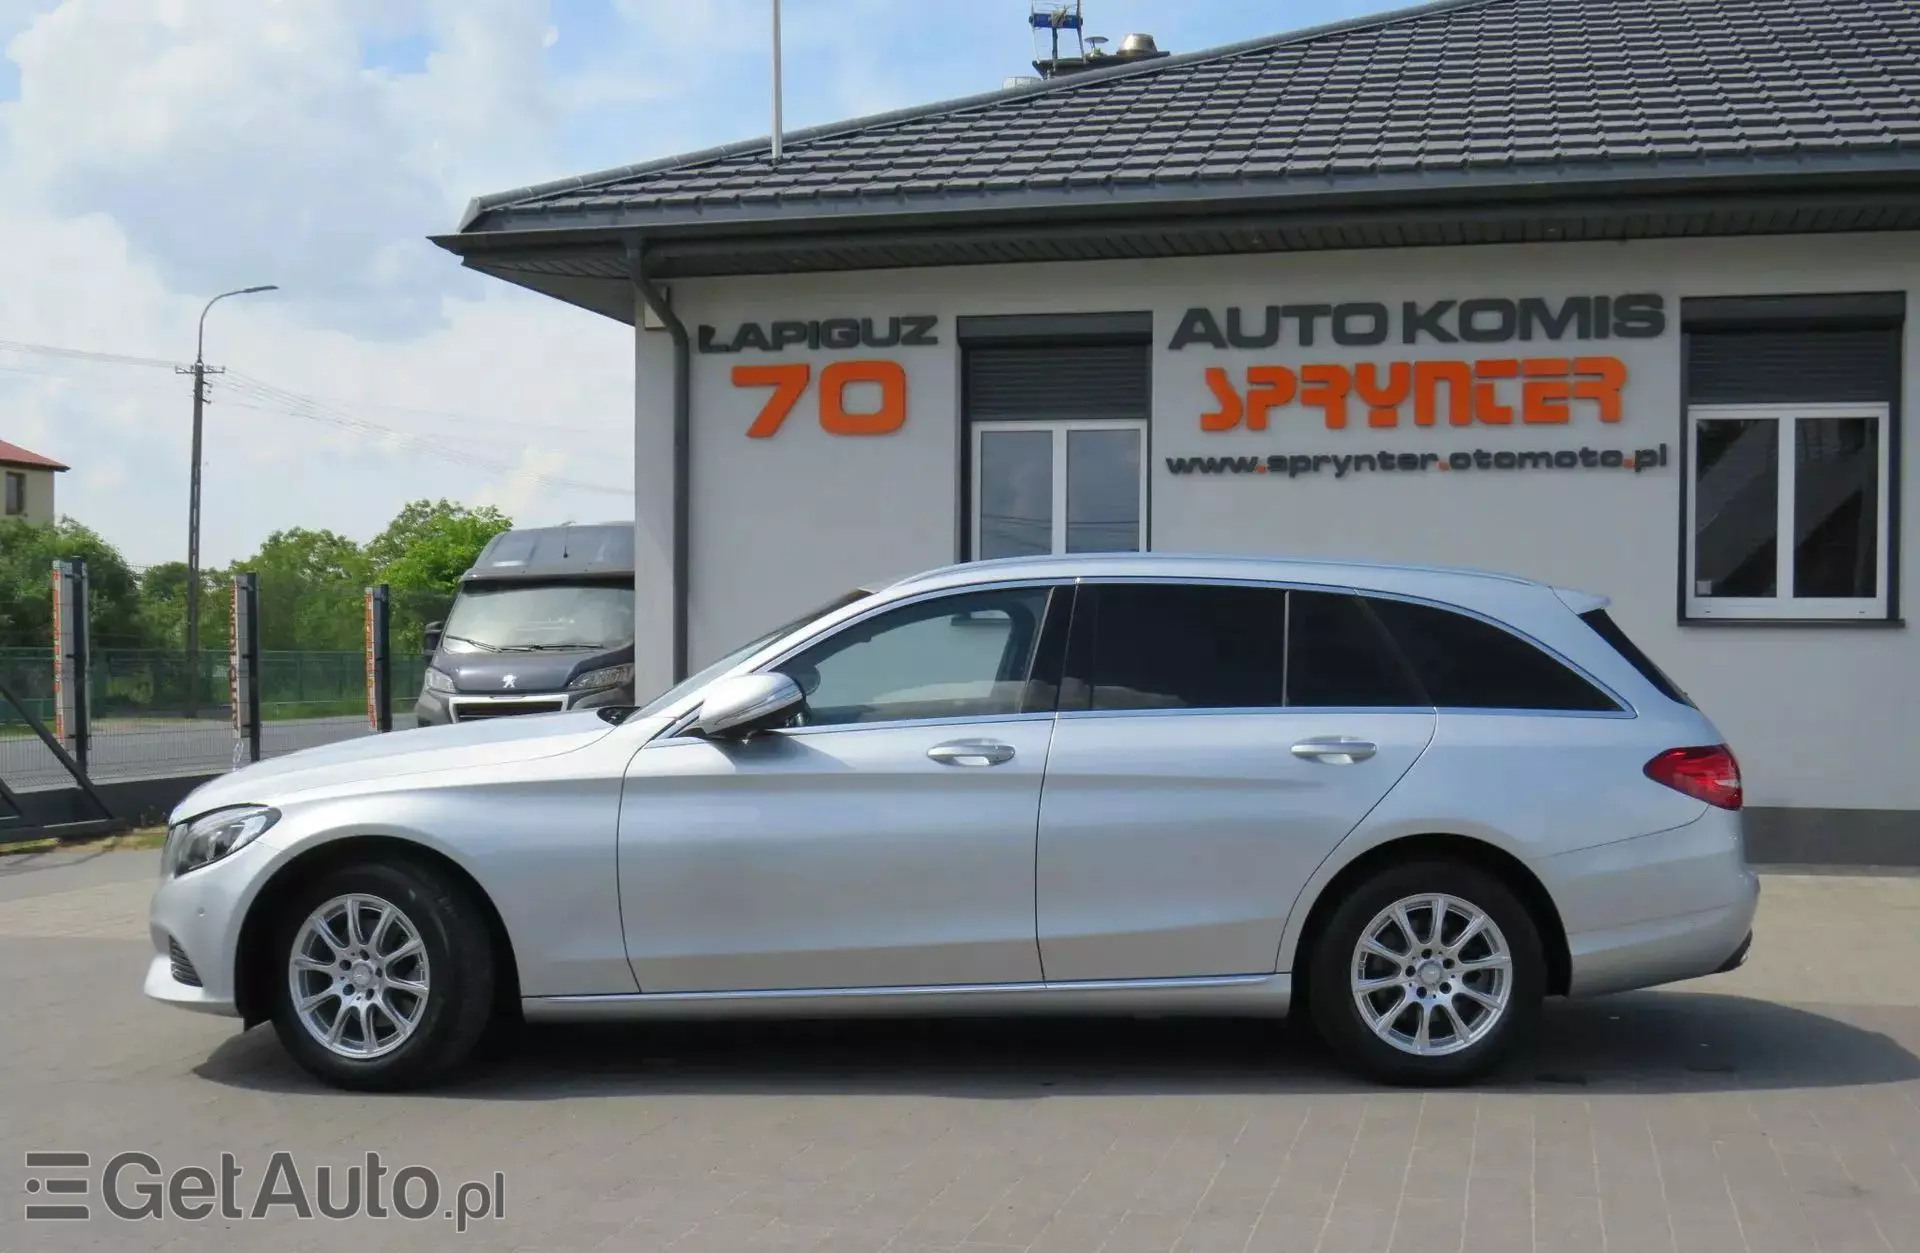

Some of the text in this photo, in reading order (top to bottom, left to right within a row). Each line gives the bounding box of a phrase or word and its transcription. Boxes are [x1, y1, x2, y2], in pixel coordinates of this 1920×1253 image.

[1168, 293, 1665, 350] AUTO KOMIS
[731, 360, 907, 438] 70
[1200, 356, 1627, 432] SPRYNTER
[1165, 443, 1668, 479] www.sprynter.otomoto.pl
